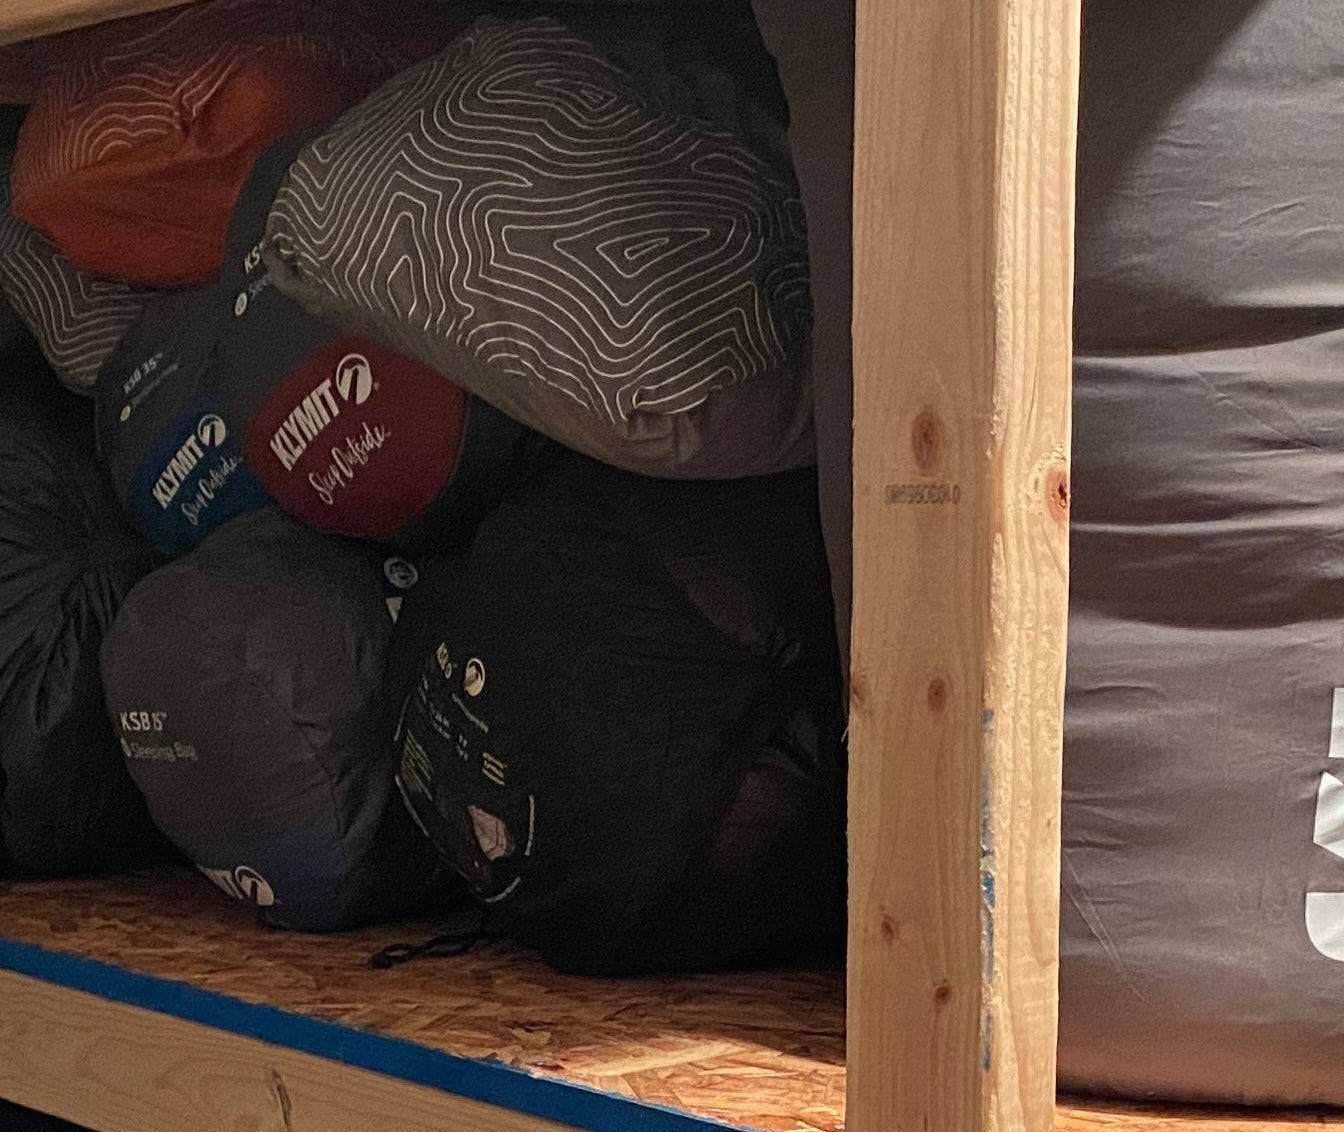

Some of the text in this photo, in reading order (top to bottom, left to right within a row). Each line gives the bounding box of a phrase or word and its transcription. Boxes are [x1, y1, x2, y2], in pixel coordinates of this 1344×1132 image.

[269, 378, 340, 472] KLYMIT
[308, 421, 387, 506] Sleep Outside
[152, 434, 204, 509] KLYMIT
[120, 711, 150, 732] KSB
